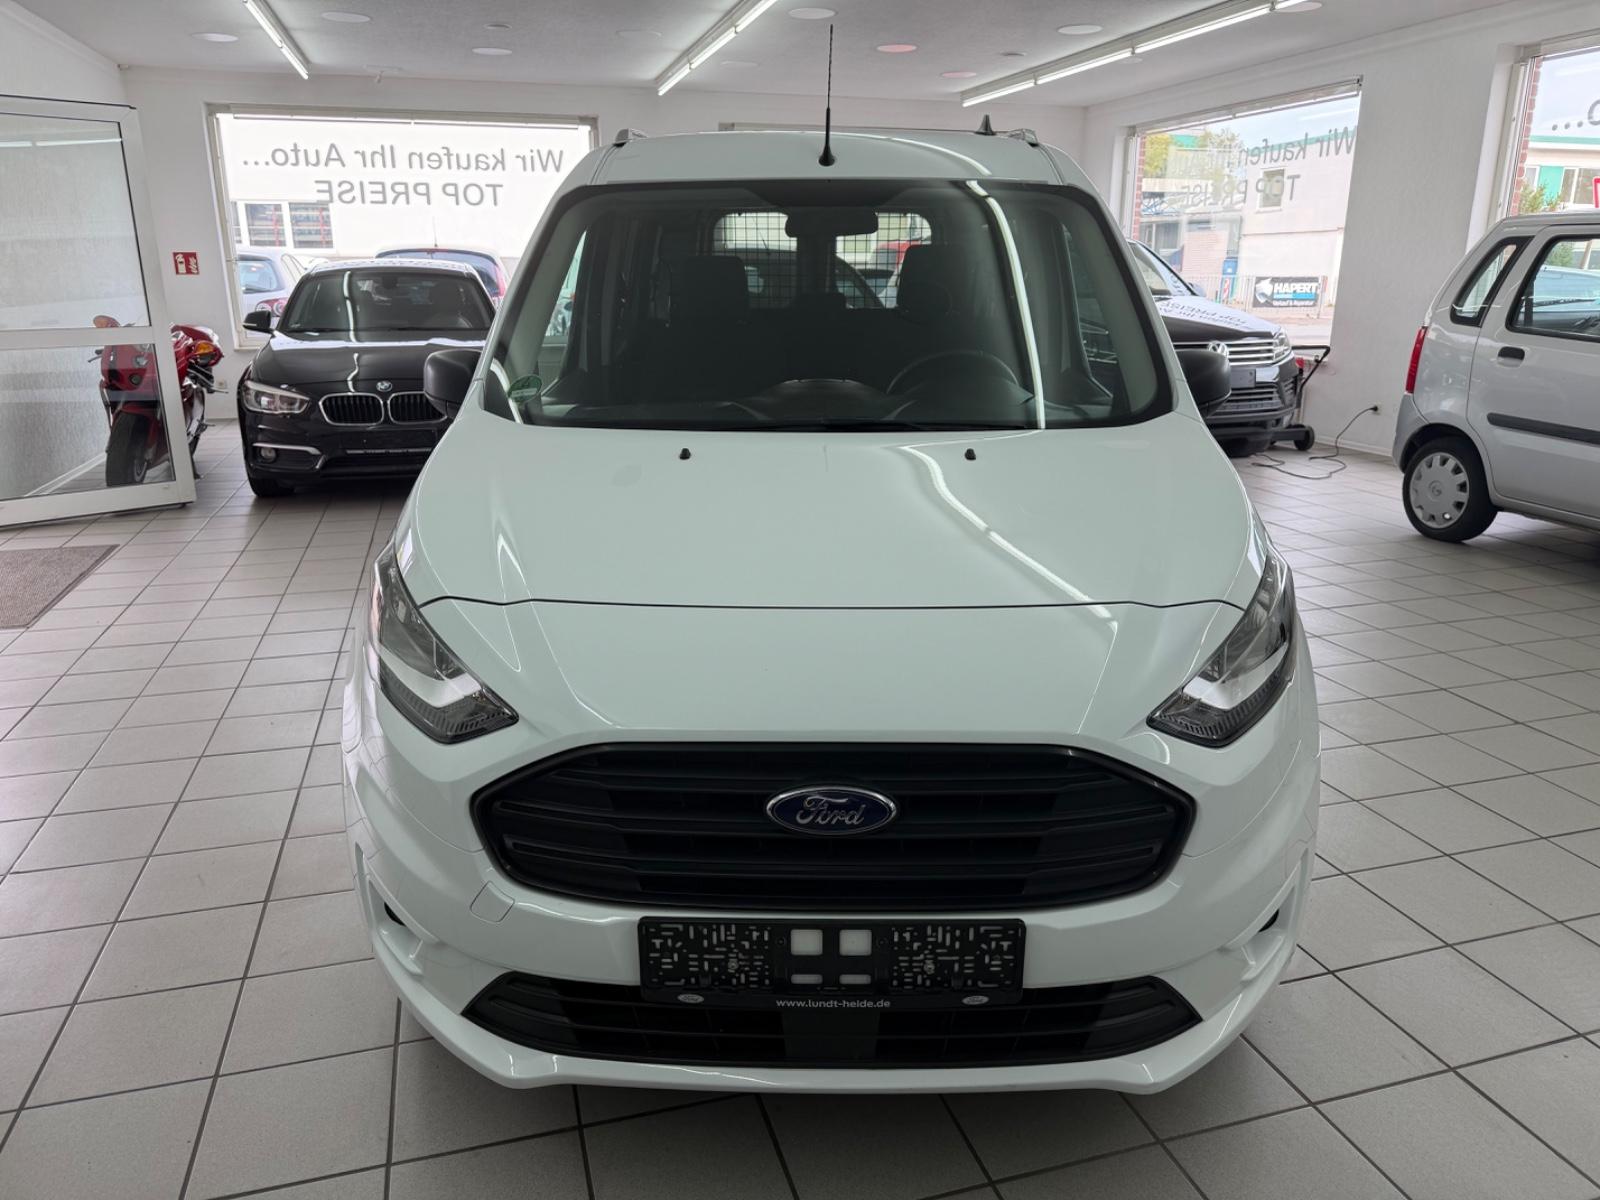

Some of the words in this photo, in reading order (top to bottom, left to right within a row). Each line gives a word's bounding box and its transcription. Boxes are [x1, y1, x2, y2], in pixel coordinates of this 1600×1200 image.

[1274, 282, 1318, 293] HAPERT
[796, 795, 866, 825] Ford
[775, 999, 891, 1009] www.lundt-heide.de
